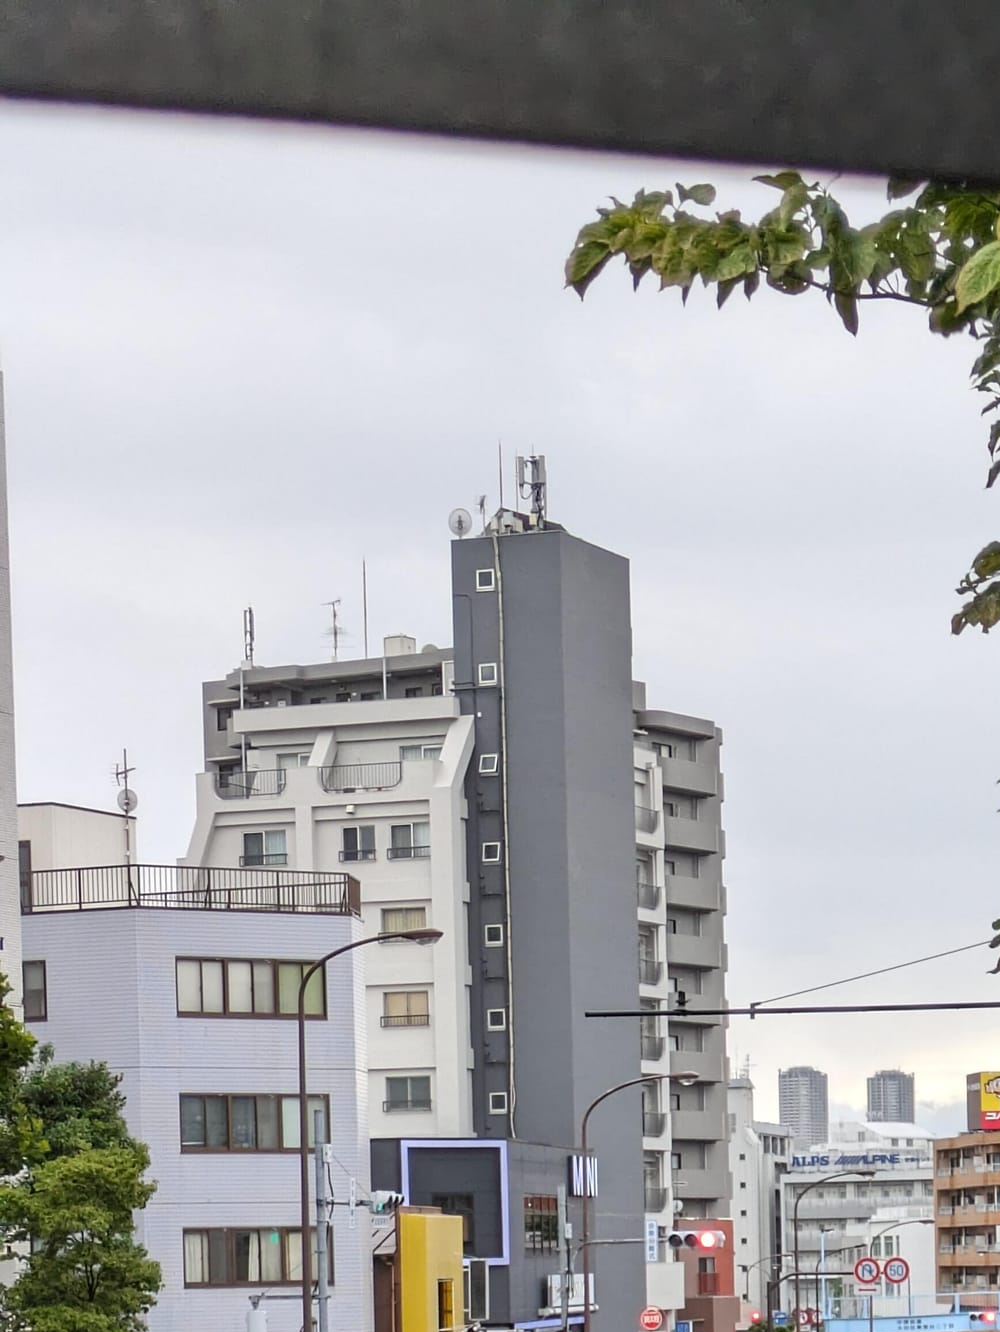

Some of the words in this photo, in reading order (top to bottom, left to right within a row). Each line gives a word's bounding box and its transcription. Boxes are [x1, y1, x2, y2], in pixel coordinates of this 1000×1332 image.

[792, 1155, 830, 1167] ALPS
[845, 1153, 900, 1166] ALPINE
[572, 1154, 599, 1198] MNI
[889, 1264, 904, 1277] 50
